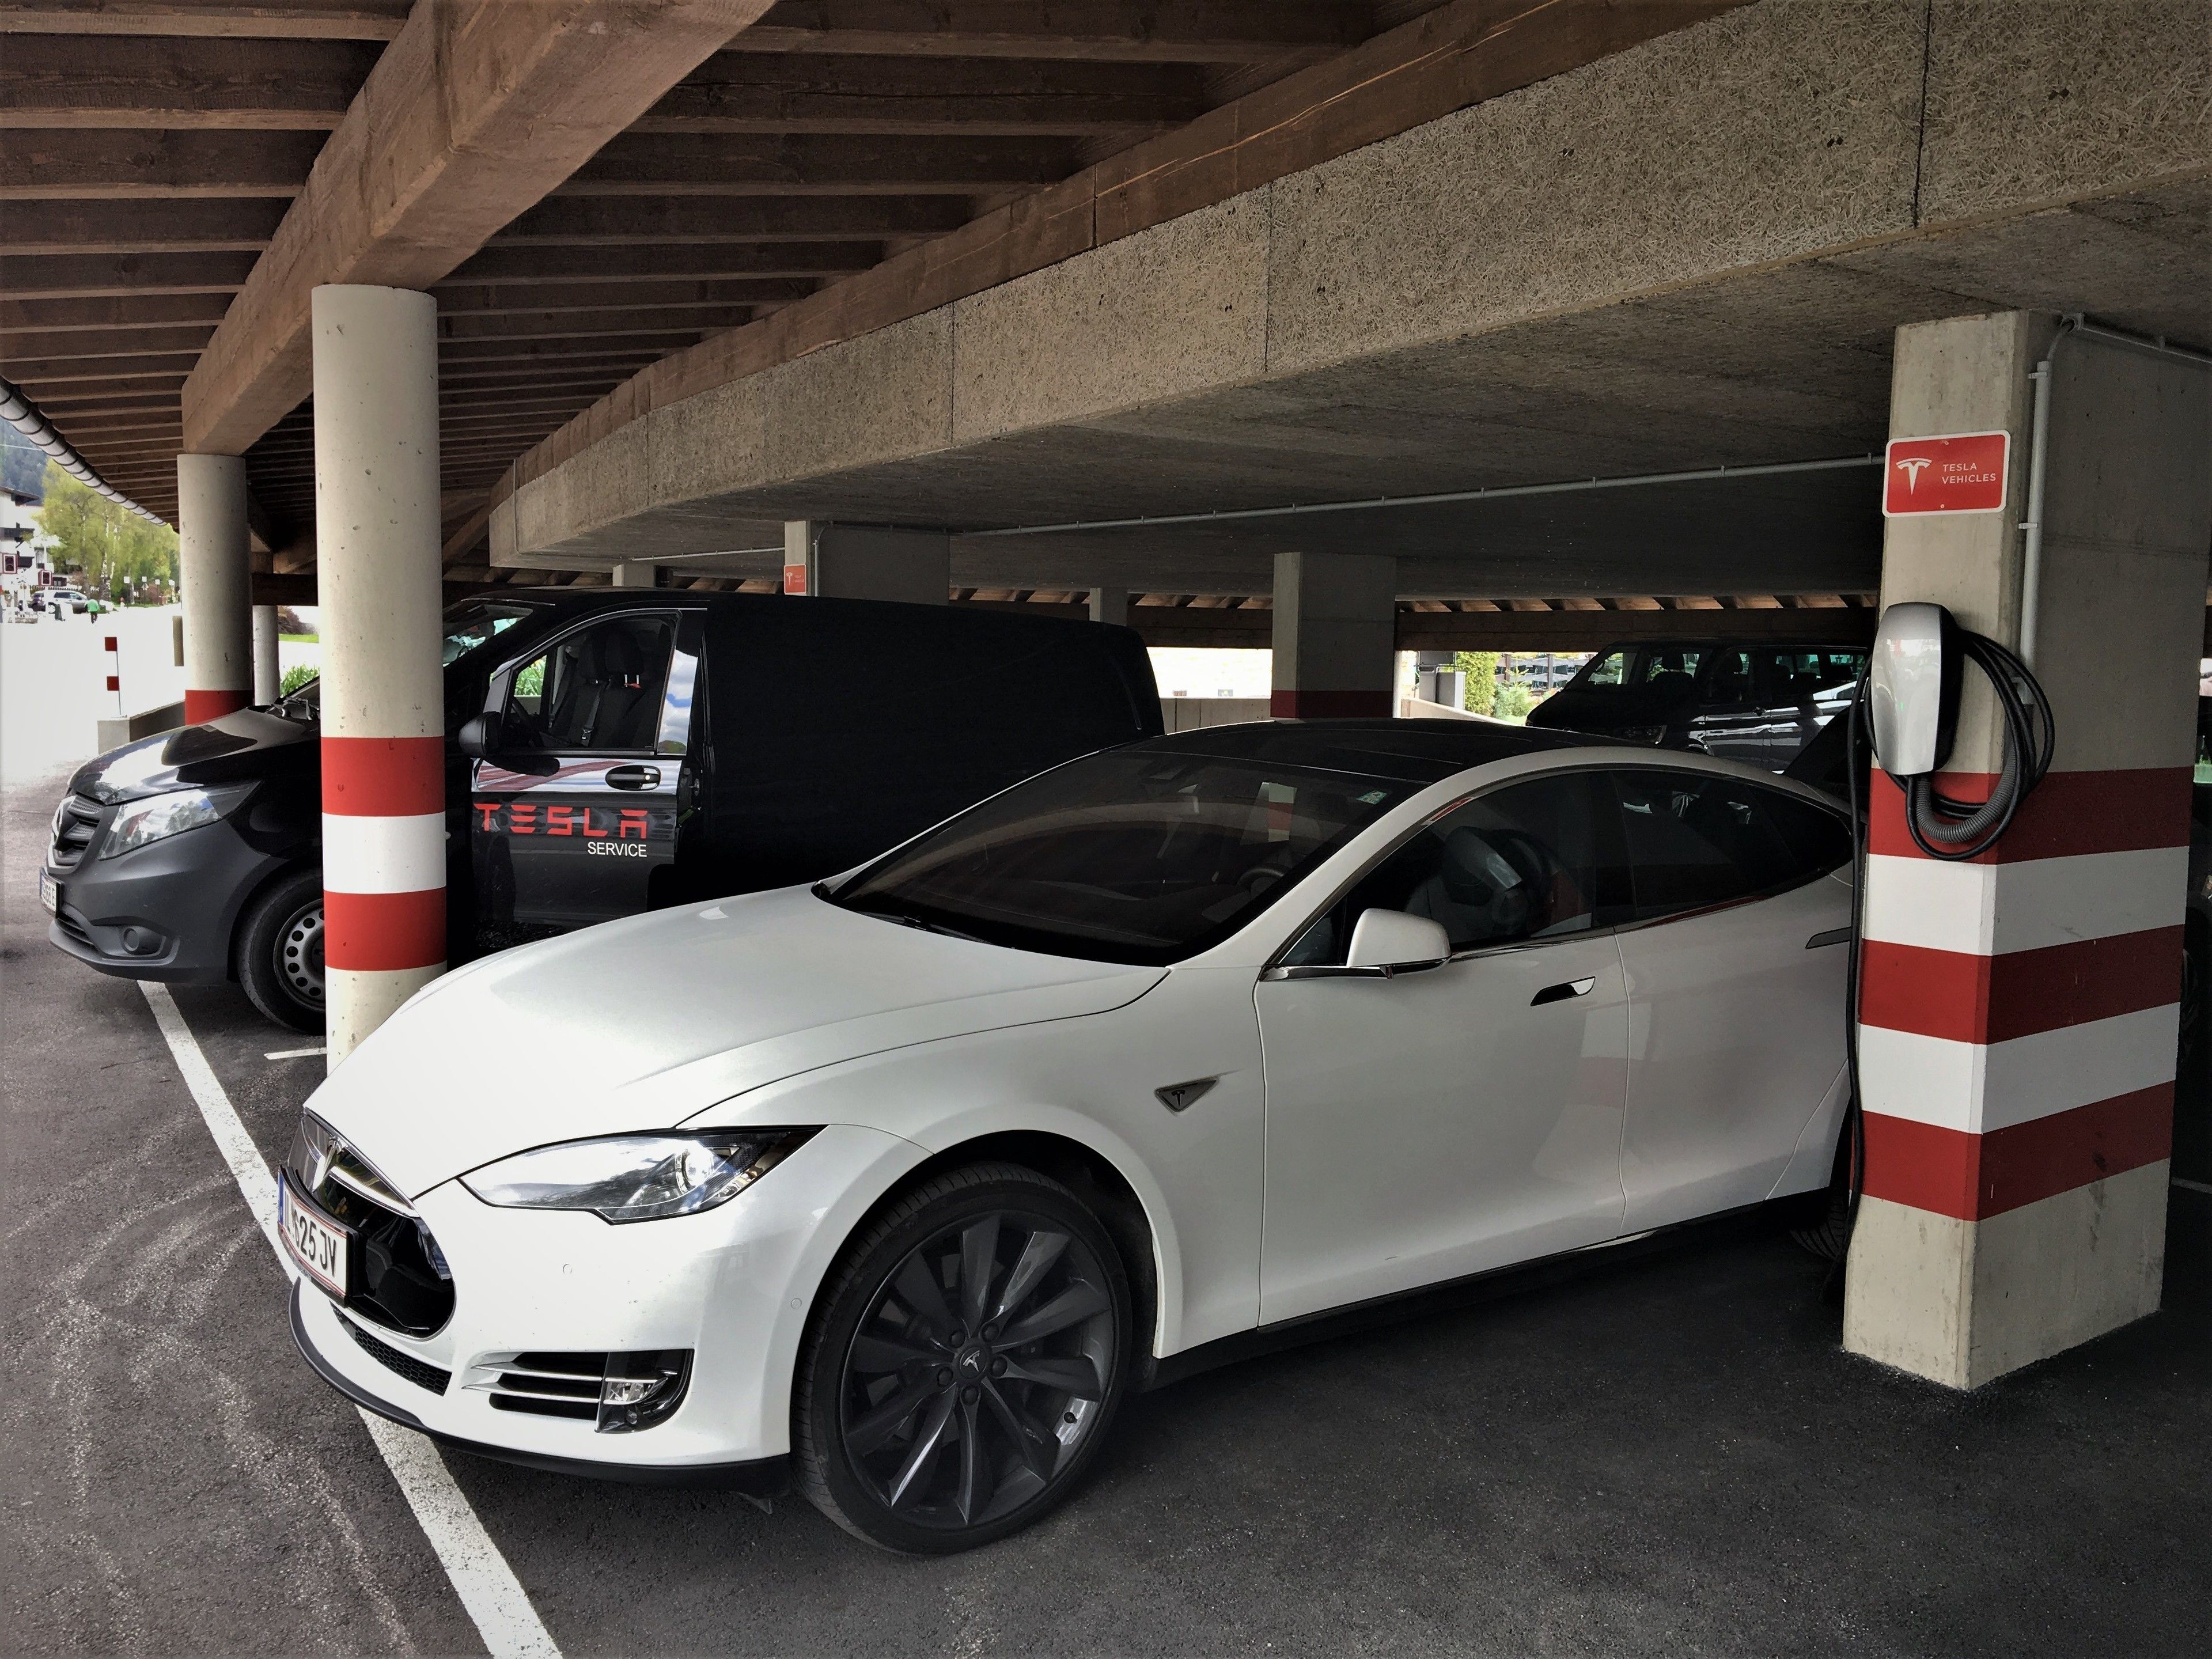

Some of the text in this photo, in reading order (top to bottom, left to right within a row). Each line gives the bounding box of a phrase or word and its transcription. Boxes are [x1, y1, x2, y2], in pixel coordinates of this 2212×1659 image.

[1943, 463, 1977, 472] TESLA
[1942, 473, 1996, 484] VEHICLES
[474, 804, 647, 839] TESLA
[588, 842, 647, 857] SERVICE
[320, 1229, 336, 1278] JV
